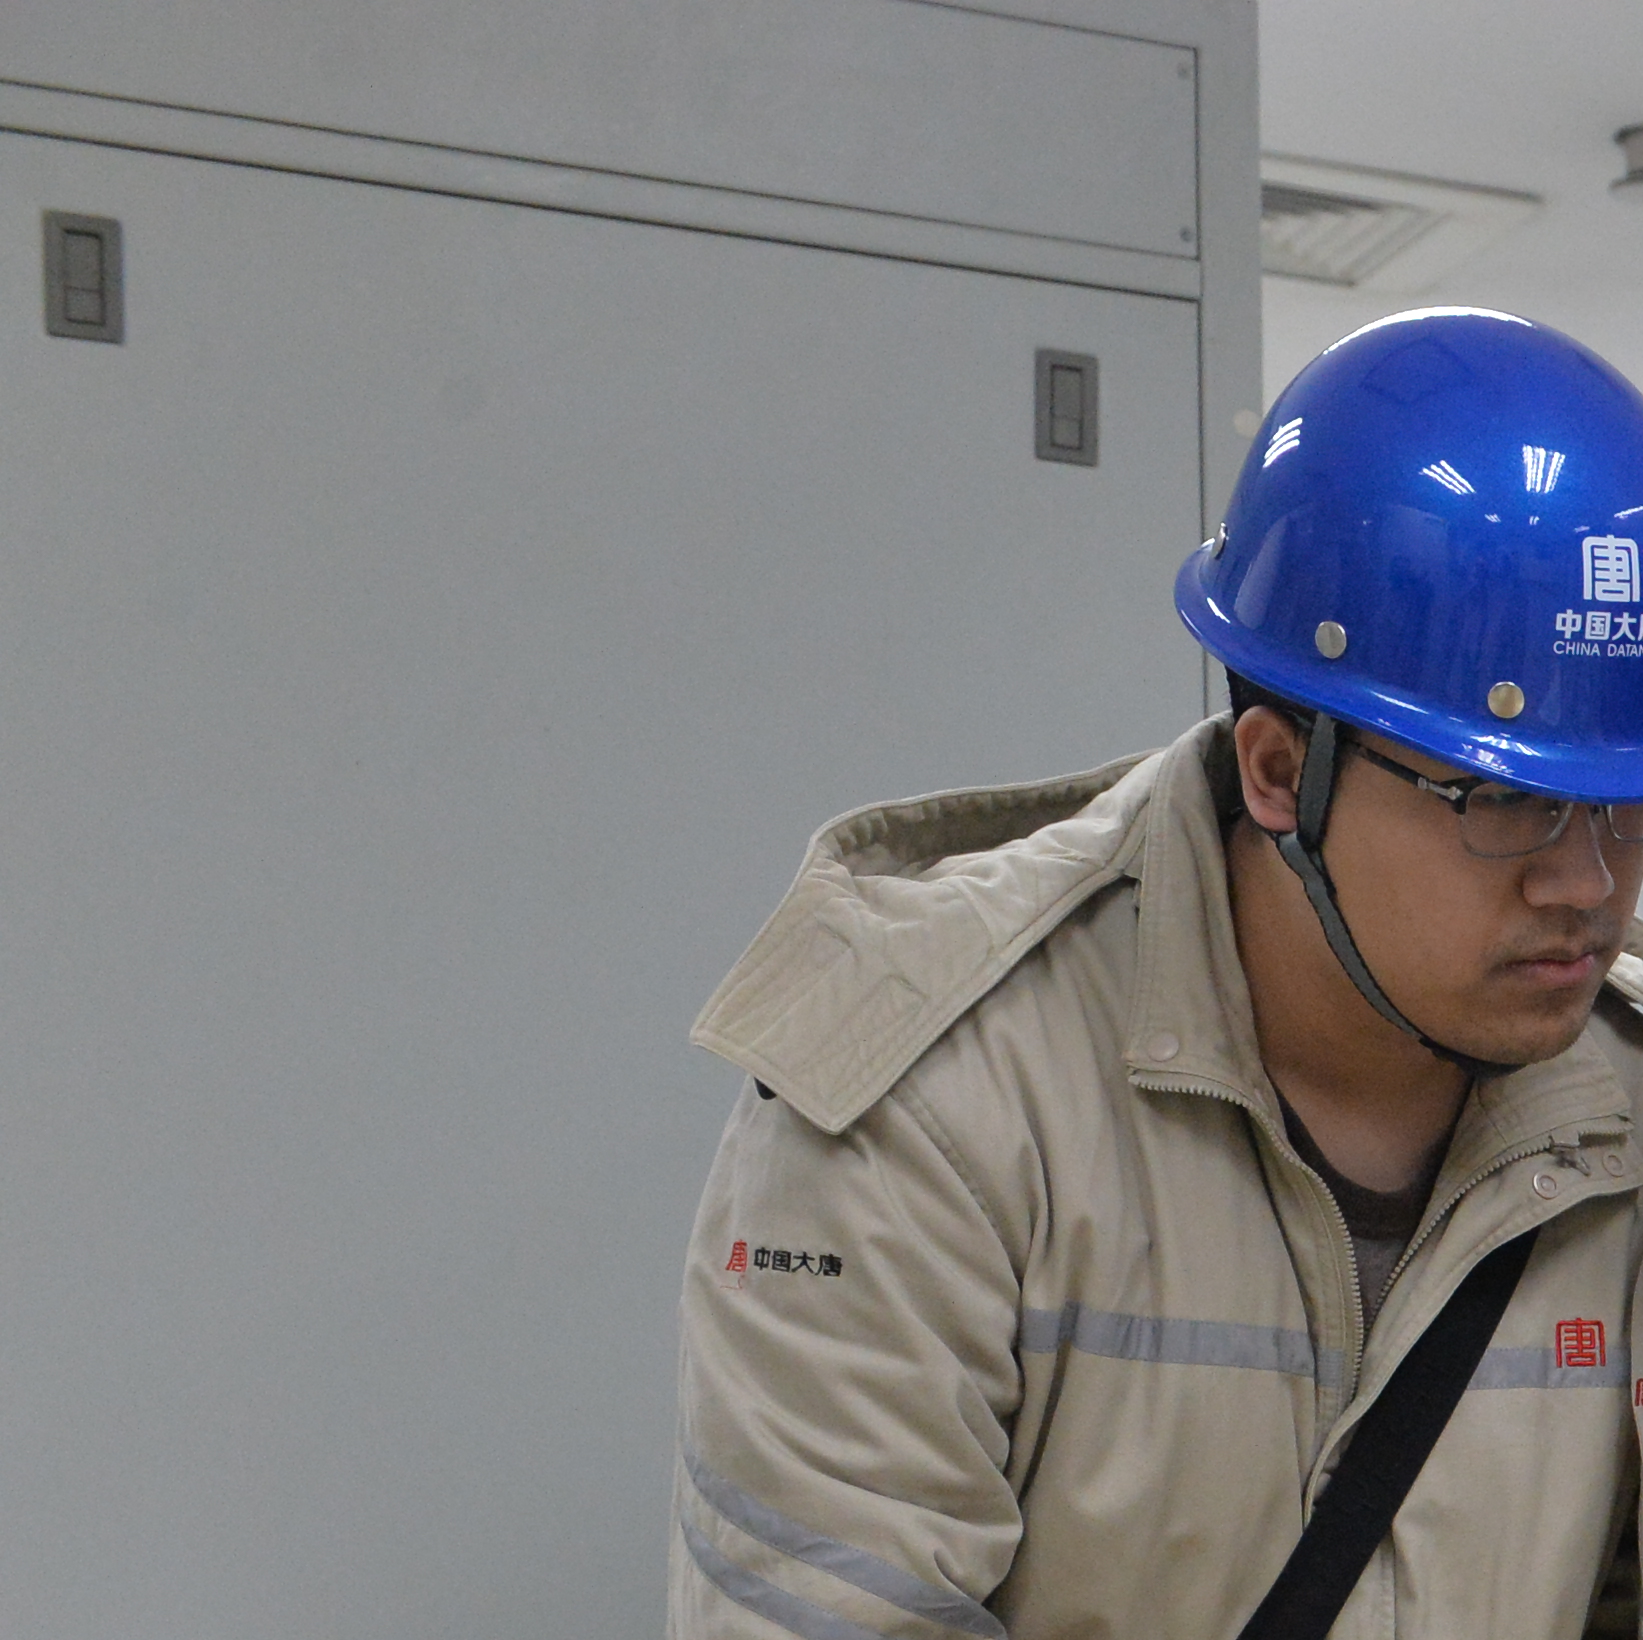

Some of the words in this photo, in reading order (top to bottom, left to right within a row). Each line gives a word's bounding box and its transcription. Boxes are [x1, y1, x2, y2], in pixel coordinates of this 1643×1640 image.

[1553, 640, 1601, 657] CHINA
[753, 1246, 843, 1277] 中国大唐
